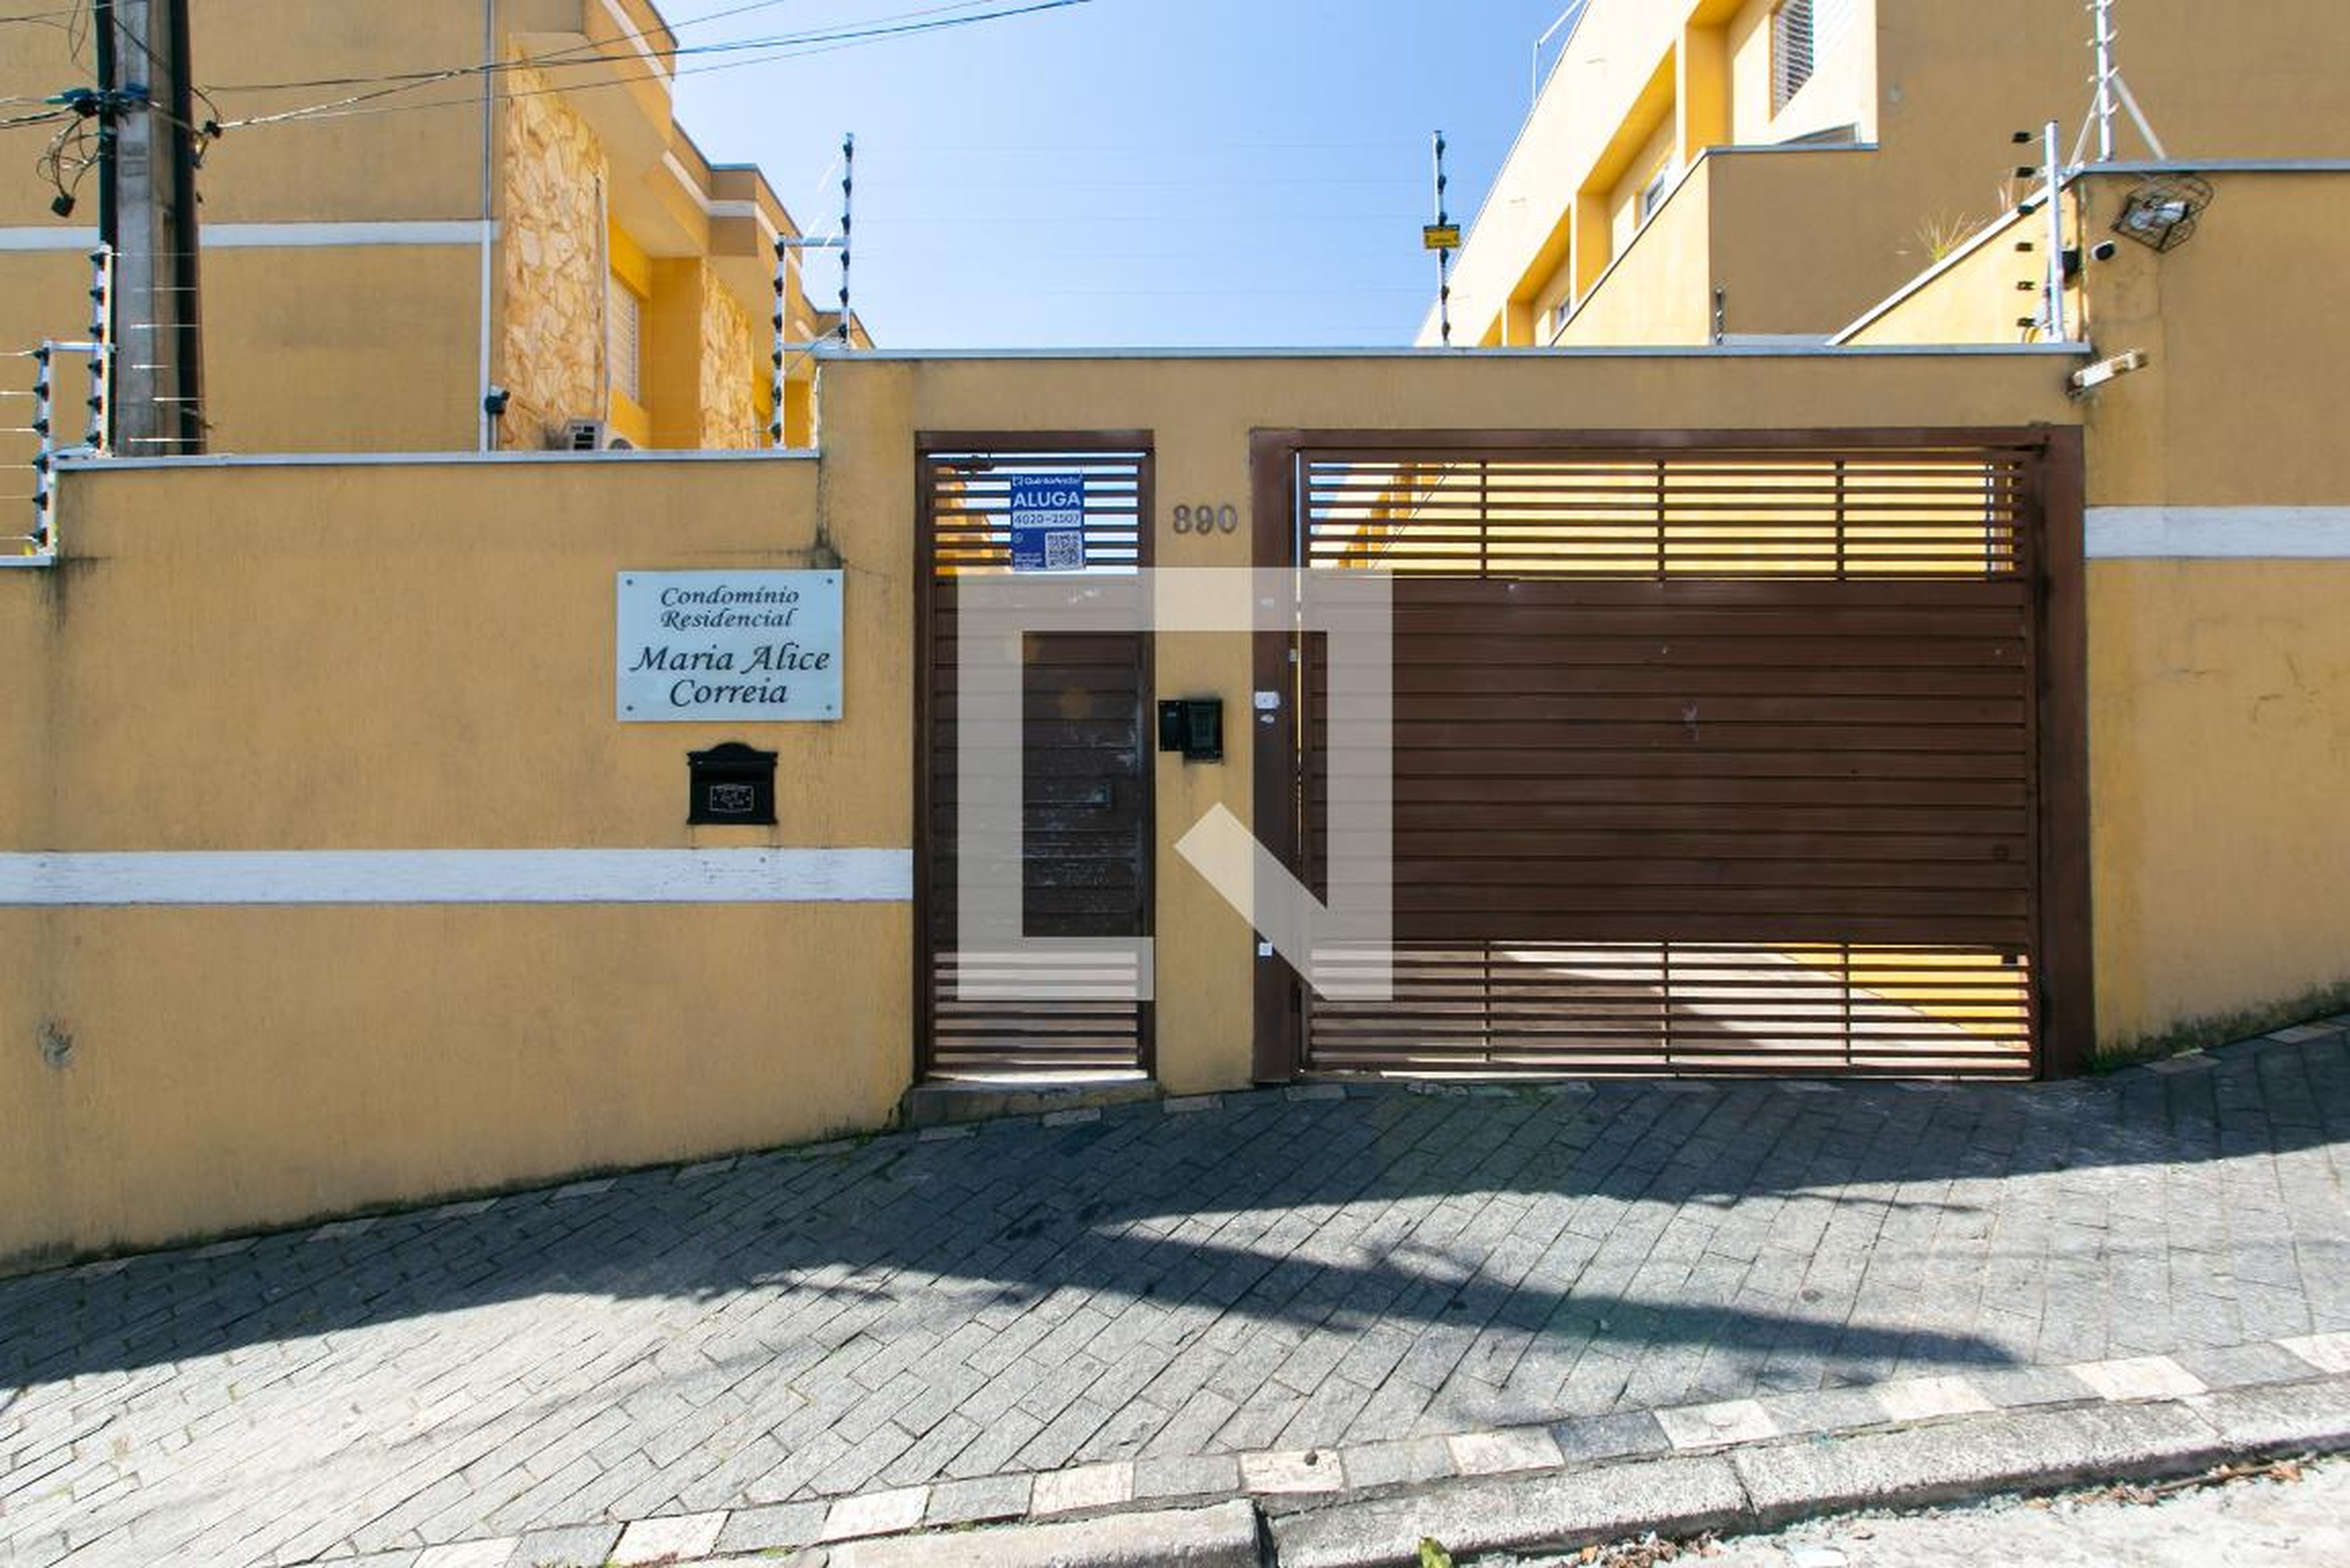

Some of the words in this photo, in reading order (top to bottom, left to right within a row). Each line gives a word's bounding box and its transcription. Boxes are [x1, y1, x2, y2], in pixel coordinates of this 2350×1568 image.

[1013, 491, 1081, 507] ALUGA
[1173, 504, 1238, 535] 890
[660, 608, 799, 631] Residencial
[629, 643, 734, 672] Maria
[739, 641, 830, 674] Alice
[670, 676, 788, 707] Correia
